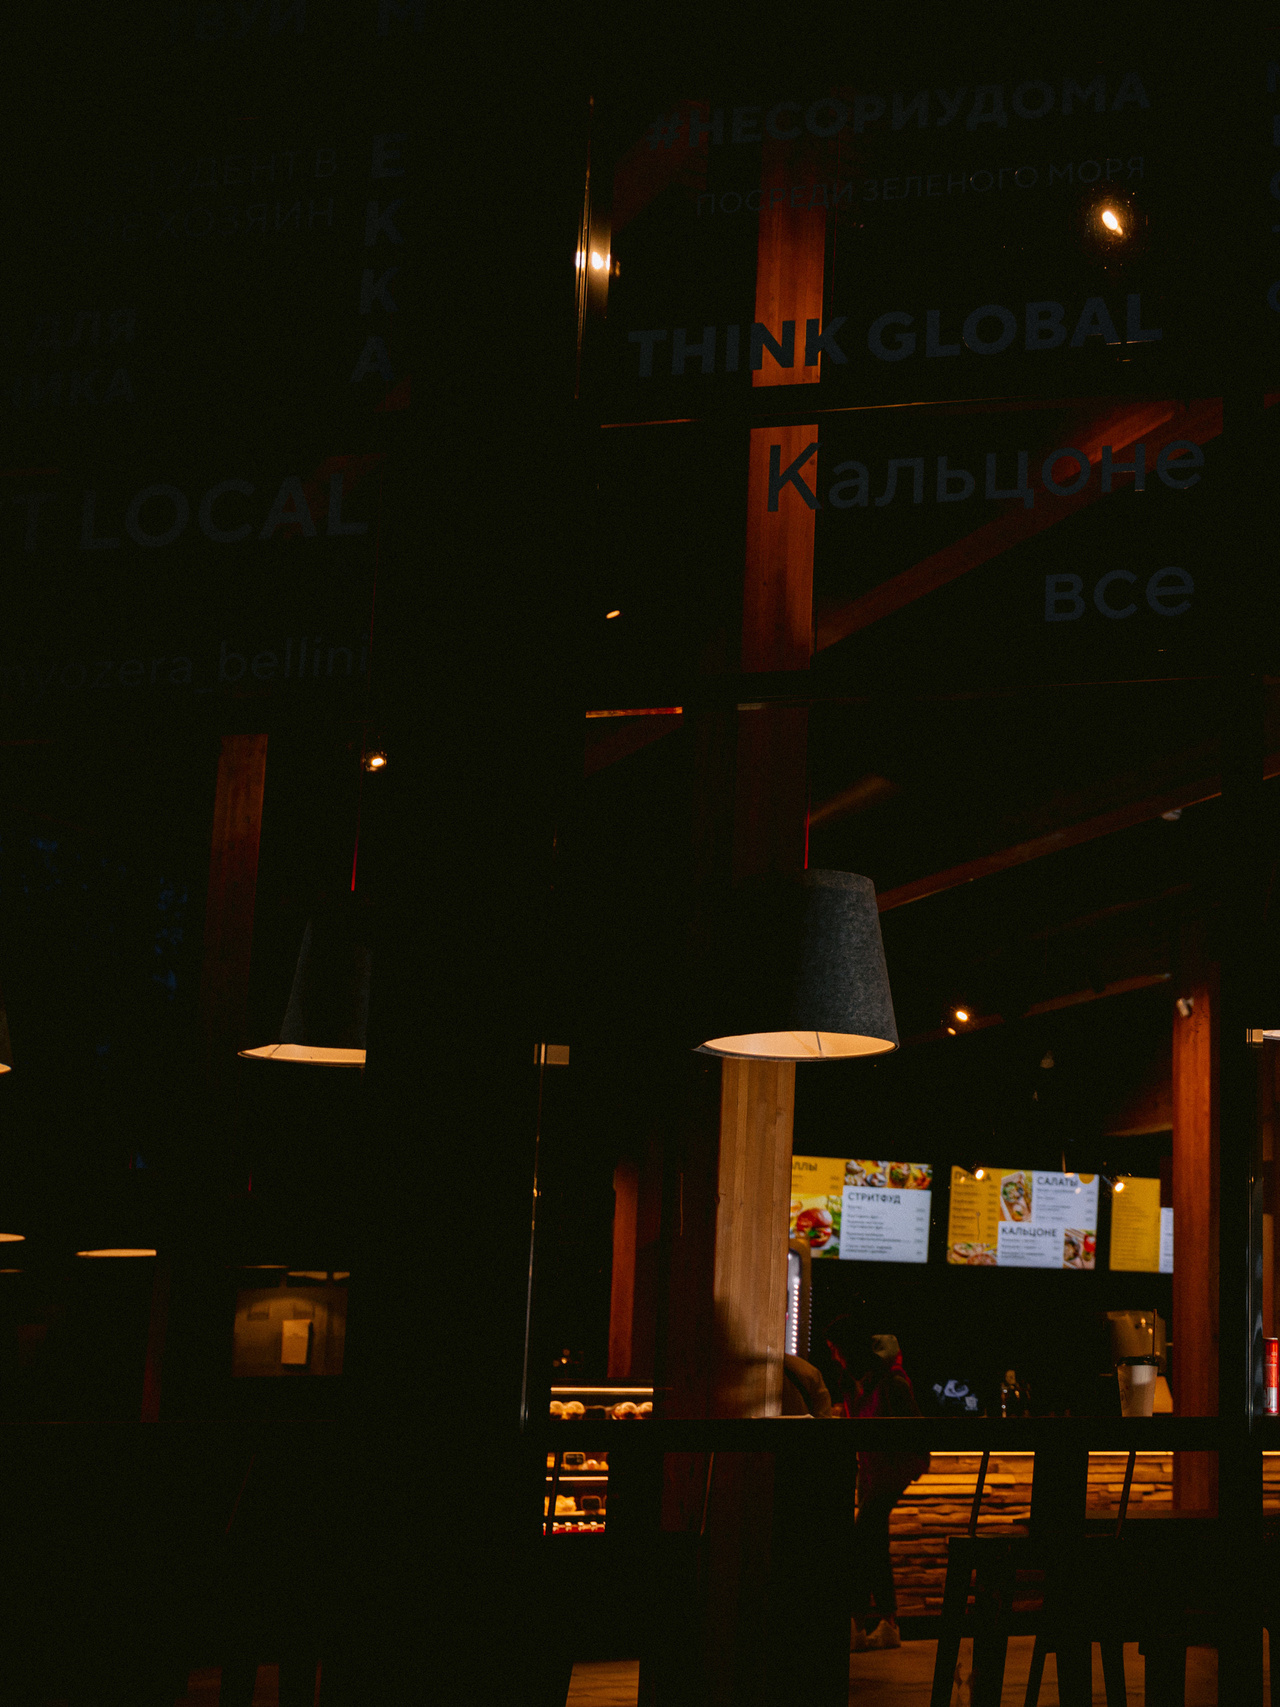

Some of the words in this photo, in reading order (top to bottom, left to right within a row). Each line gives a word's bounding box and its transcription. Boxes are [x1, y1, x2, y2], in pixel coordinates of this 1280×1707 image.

[1047, 154, 1146, 187] МОРЯ
[626, 314, 850, 379] THINK
[866, 291, 1164, 364] GLOBAL
[765, 438, 1206, 515] Кальцоне
[78, 471, 369, 551] LOCAL
[1041, 564, 1196, 624] все
[1001, 1227, 1058, 1238] КАЛЬЦОНЕ
